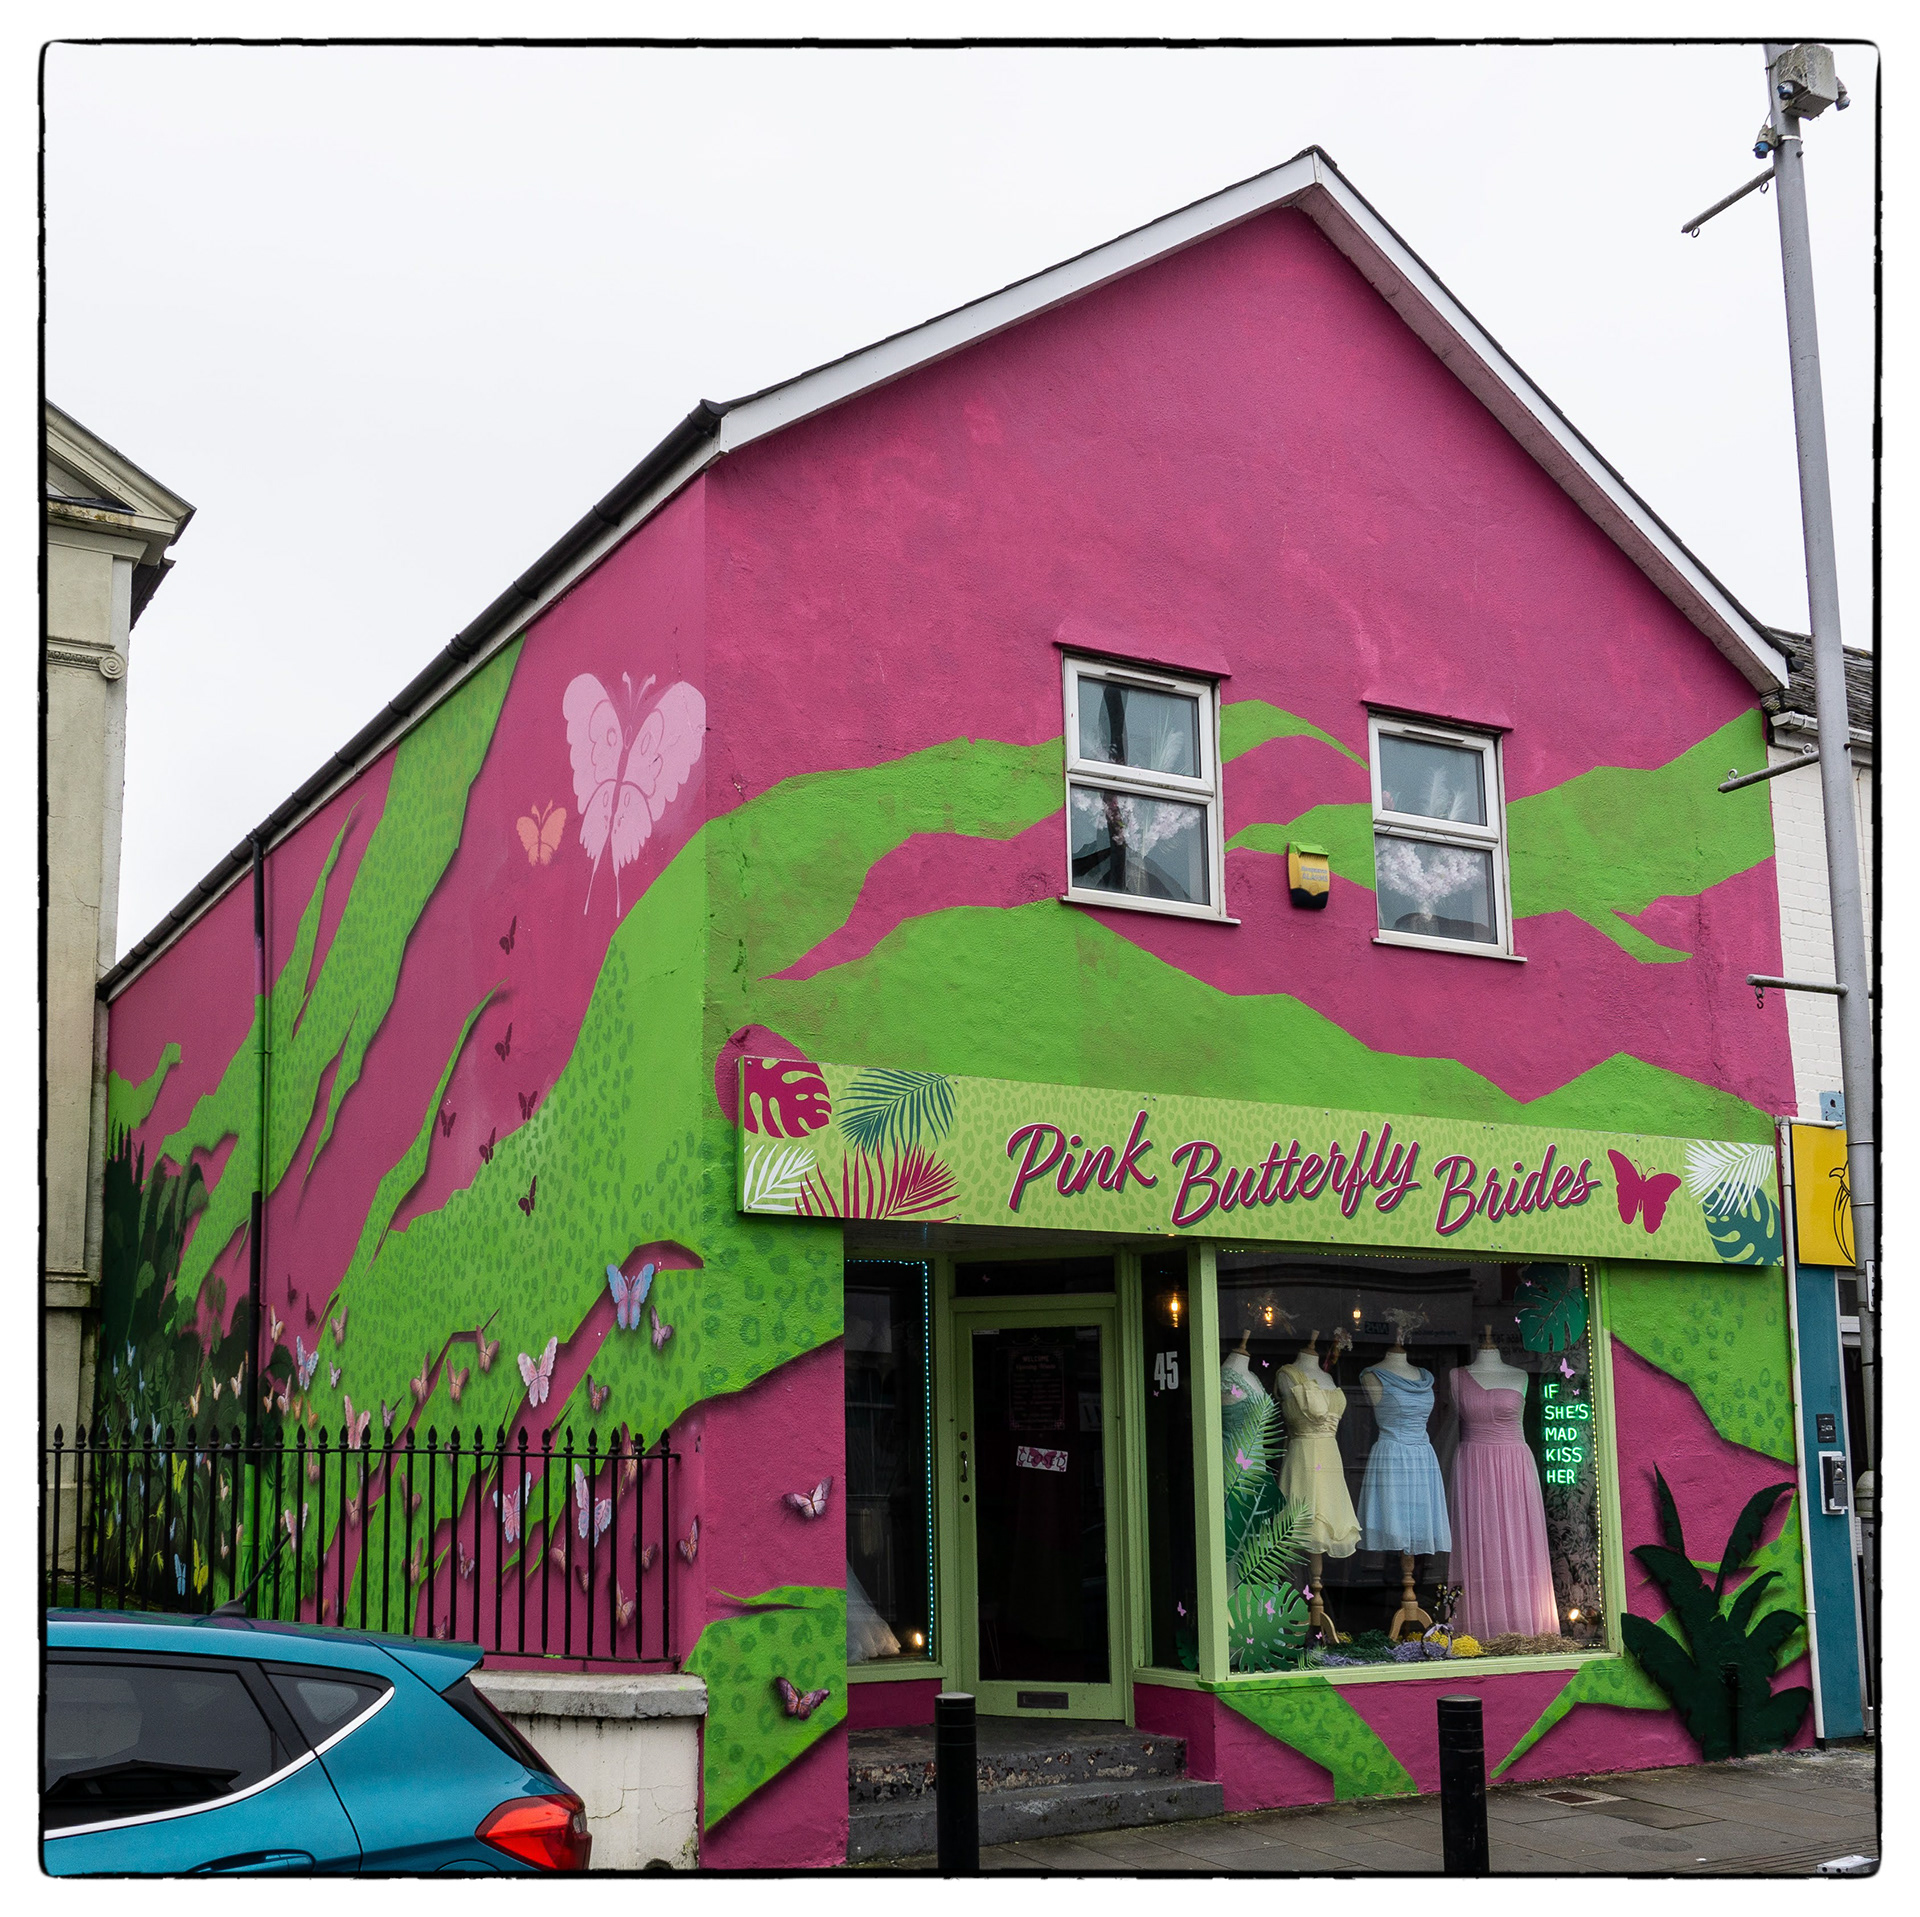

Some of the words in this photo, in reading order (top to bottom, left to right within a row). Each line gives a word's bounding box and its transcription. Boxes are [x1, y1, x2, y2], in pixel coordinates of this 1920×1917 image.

[1006, 1110, 1158, 1213] Pink
[1170, 1121, 1422, 1228] Butterfly
[1433, 1142, 1602, 1237] Brides
[1154, 1351, 1179, 1391] 45
[1544, 1383, 1560, 1399] IF
[1544, 1404, 1590, 1421] SHE'S
[1545, 1426, 1579, 1442] MAD
[1018, 1448, 1066, 1468] CLOSED
[1545, 1446, 1584, 1463] KISS
[1546, 1468, 1577, 1485] HER
